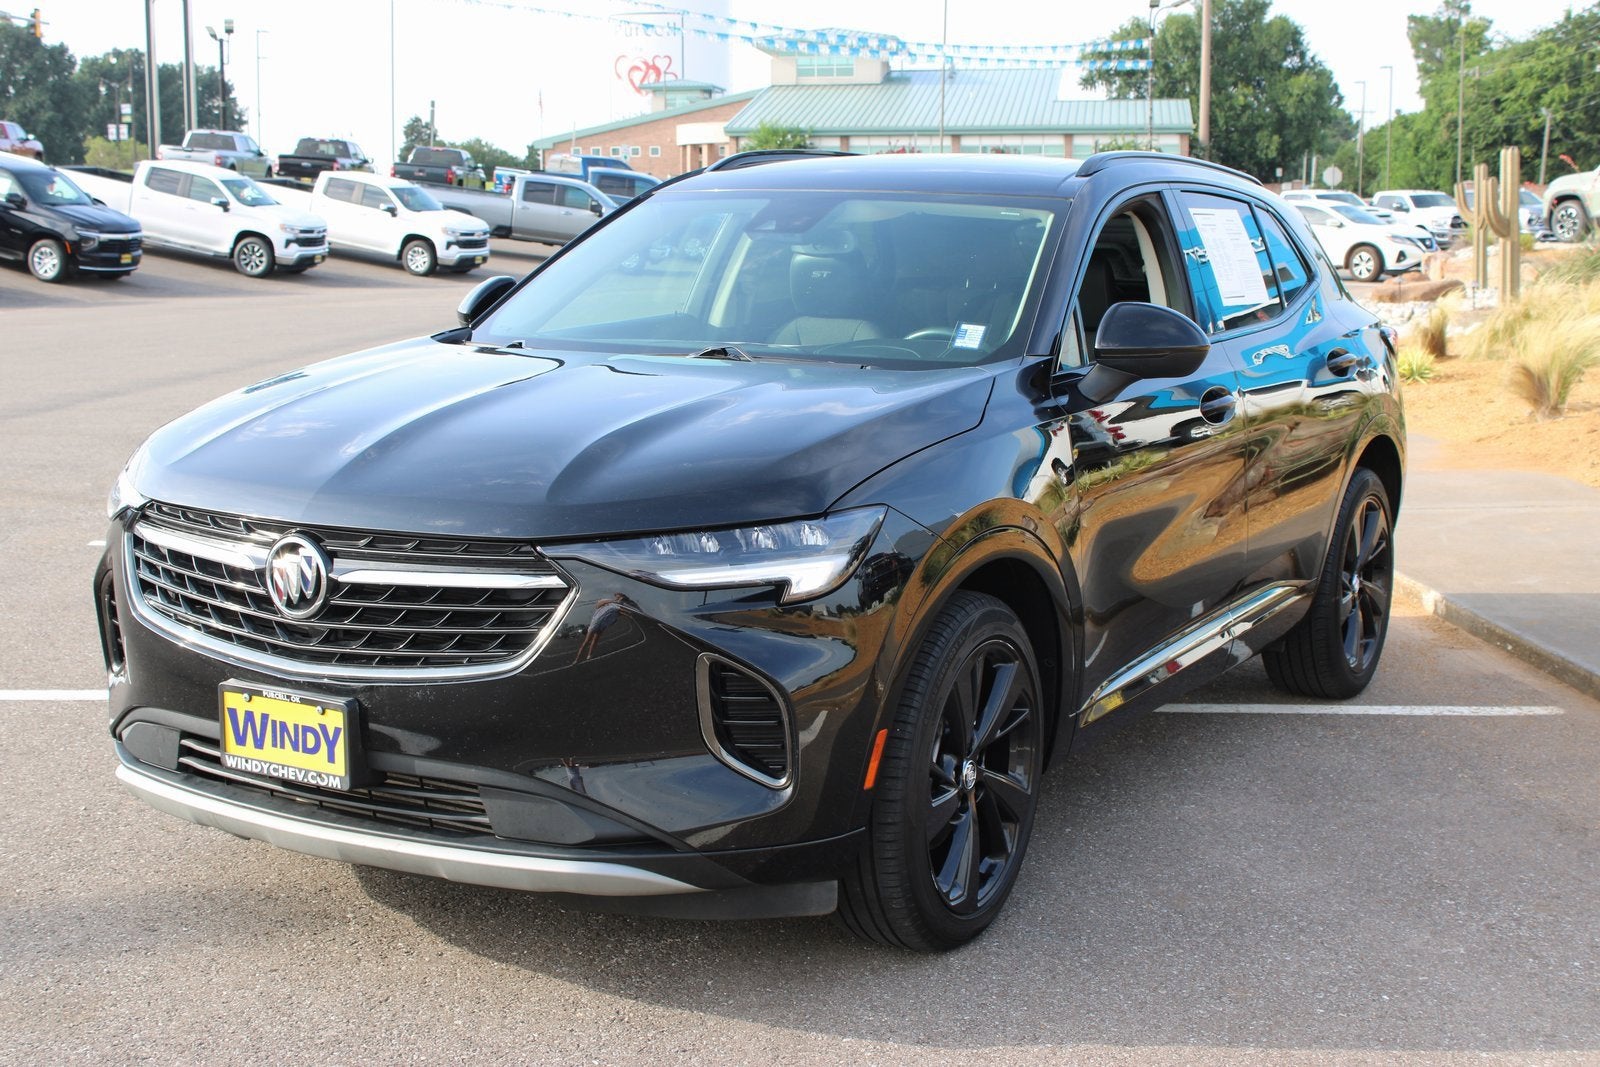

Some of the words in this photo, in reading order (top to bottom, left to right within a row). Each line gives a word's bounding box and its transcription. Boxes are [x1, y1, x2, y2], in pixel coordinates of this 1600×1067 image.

[262, 690, 290, 702] PURCELL,
[290, 694, 301, 703] OK
[227, 707, 342, 764] WINDY
[225, 755, 341, 789] WINDYCHEV.COM
